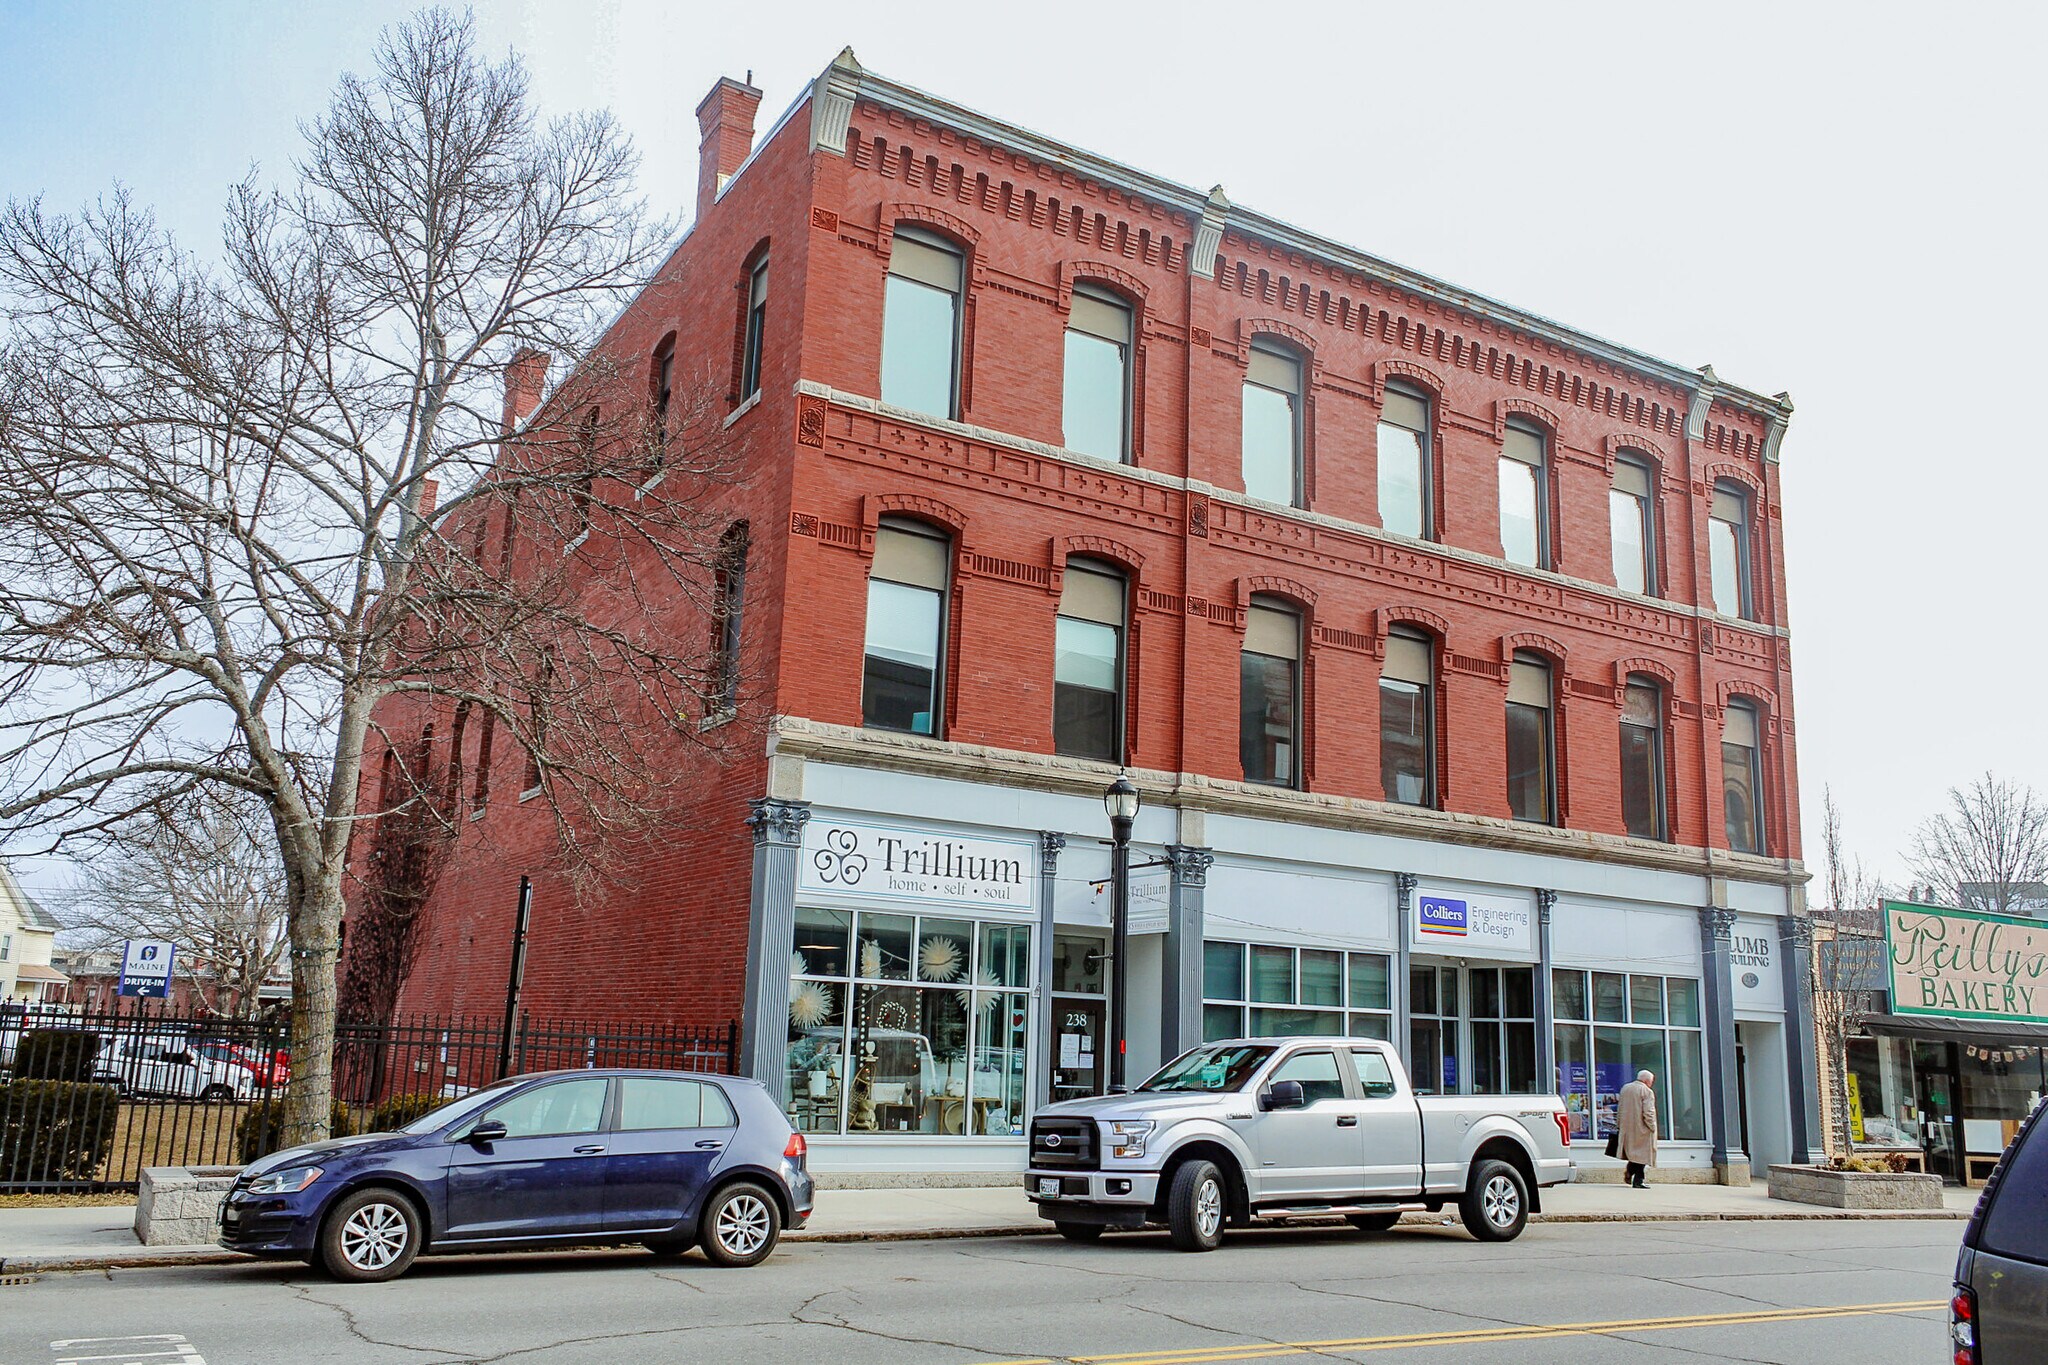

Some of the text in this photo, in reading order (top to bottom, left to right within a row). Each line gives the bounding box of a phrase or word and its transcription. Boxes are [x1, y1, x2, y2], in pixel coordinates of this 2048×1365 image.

[878, 837, 1022, 884] Trillium
[888, 875, 1010, 900] home self soul
[1130, 883, 1168, 897] Trillium
[1423, 903, 1463, 921] Colliers
[1472, 905, 1528, 926] Engineering
[1472, 920, 1515, 939] & Design
[1730, 953, 1770, 968] BUILDING
[1893, 915, 2048, 988] Reilly's
[129, 962, 166, 971] MAINE
[124, 977, 166, 987] DRIVE-IN
[1920, 976, 2034, 1015] BAKERY
[1066, 1013, 1087, 1027] 238
